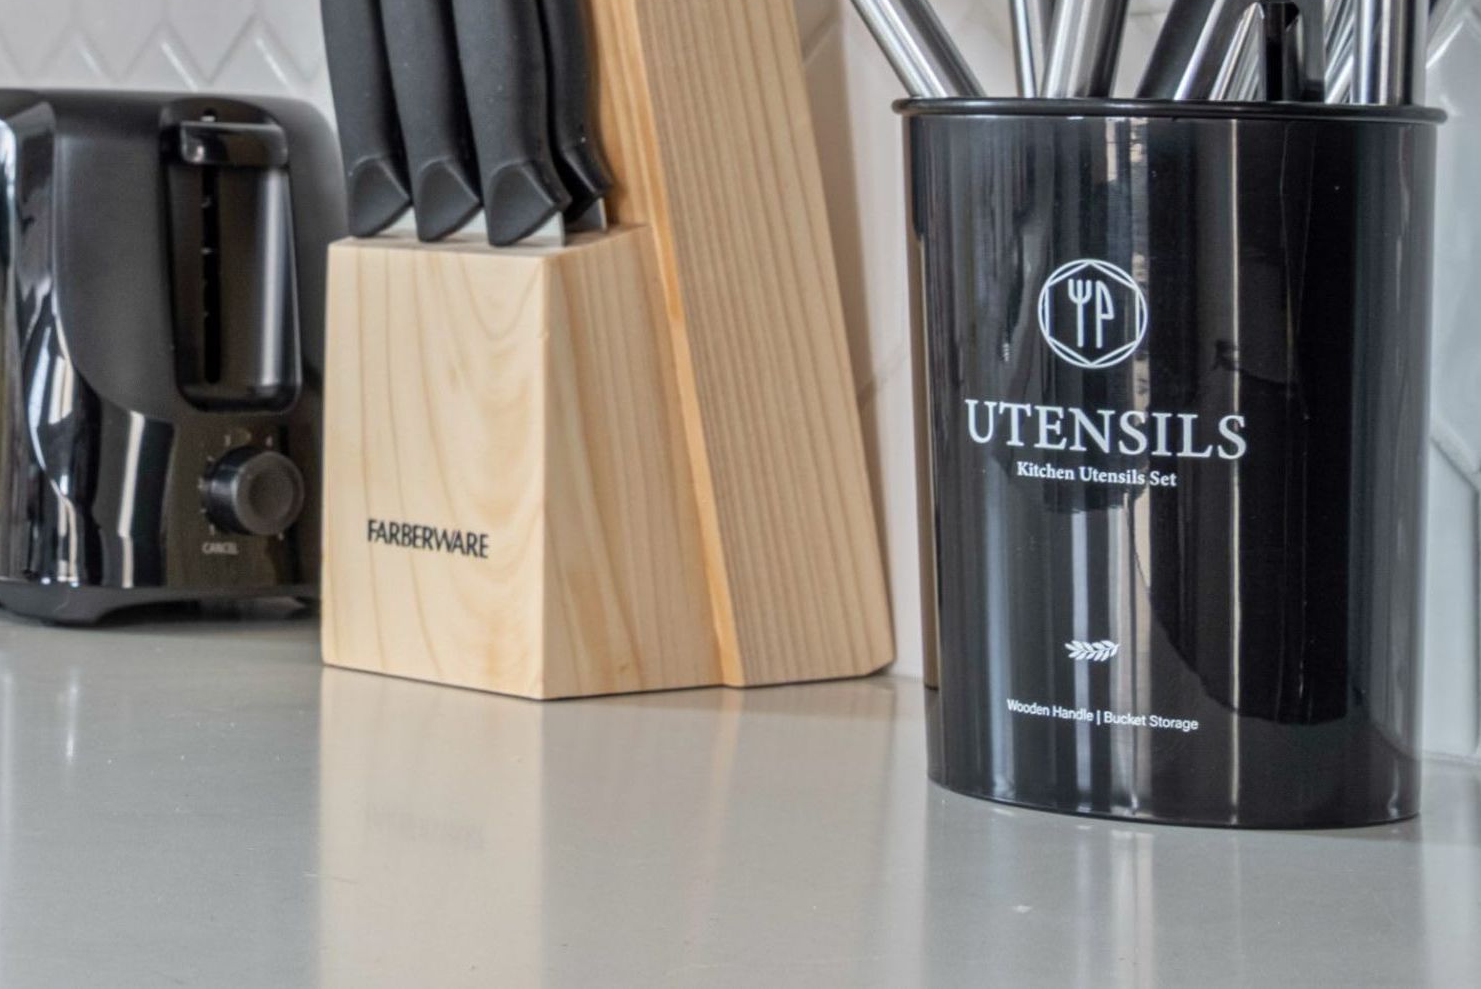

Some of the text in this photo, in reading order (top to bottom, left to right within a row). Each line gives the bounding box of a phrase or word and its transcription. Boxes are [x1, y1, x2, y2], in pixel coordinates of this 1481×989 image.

[964, 398, 1247, 459] UTENSILS
[1016, 460, 1178, 487] Kitchen Utensils Set
[367, 519, 489, 558] FARBERWARE
[1006, 698, 1050, 716] Wooden
[1052, 704, 1094, 722] Handle
[1103, 711, 1147, 727] Bucket
[1149, 715, 1199, 732] Storage
